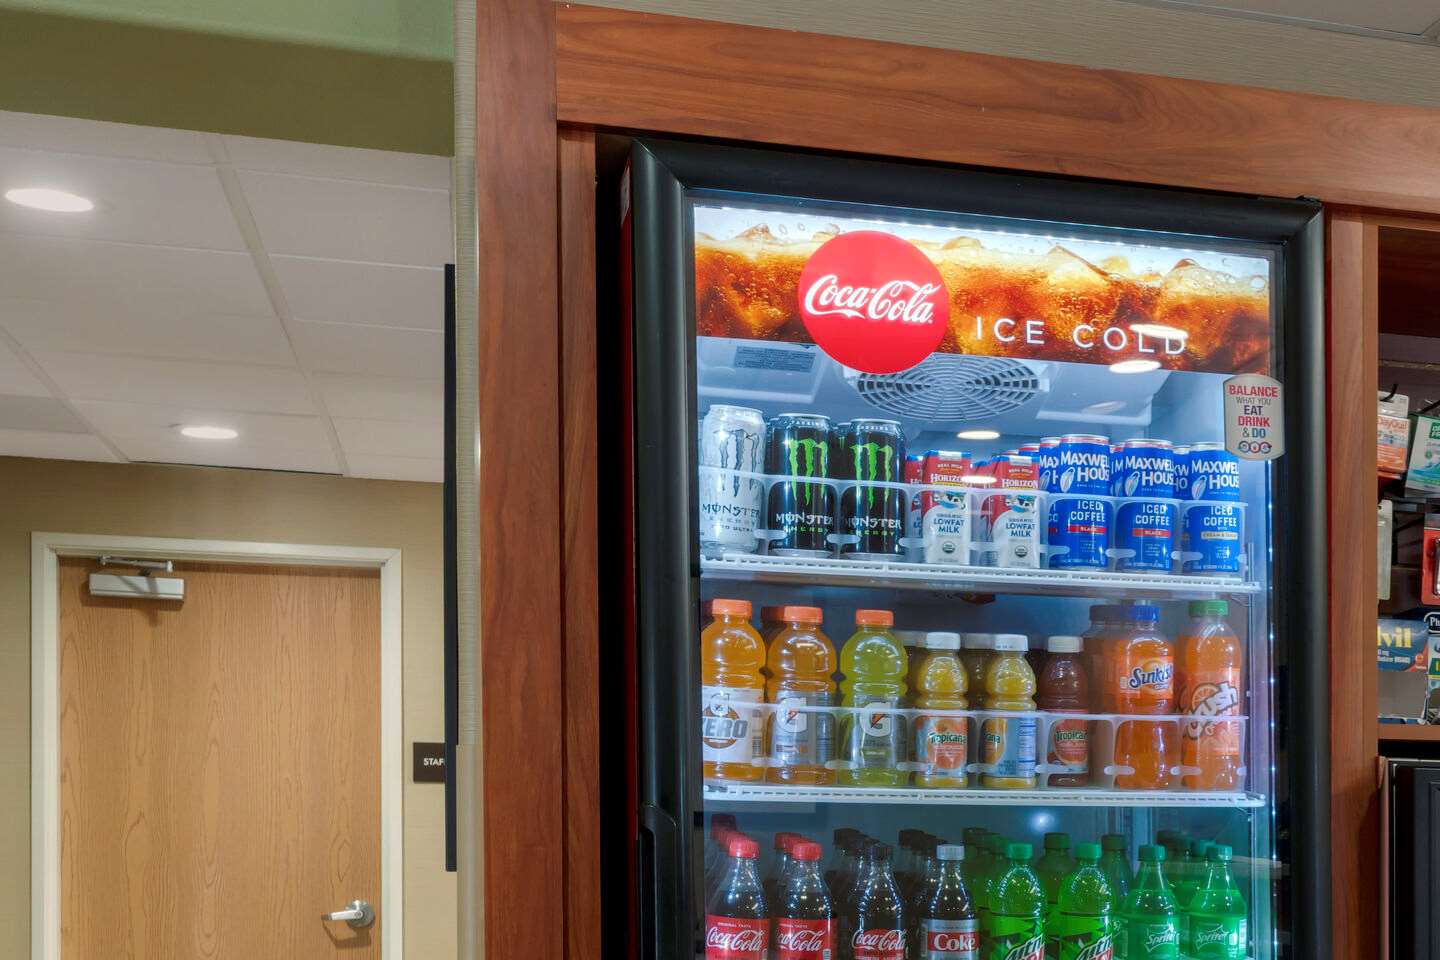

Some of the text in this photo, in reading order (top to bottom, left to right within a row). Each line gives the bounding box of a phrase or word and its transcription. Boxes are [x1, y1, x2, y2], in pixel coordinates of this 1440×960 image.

[803, 273, 942, 324] Coca-Cola
[974, 315, 1187, 356] ICE COLD
[1228, 384, 1279, 398] BALANCE
[1235, 396, 1271, 406] WHAT YOU
[1243, 404, 1264, 416] EAT
[1238, 416, 1271, 428] DRINK
[1242, 427, 1267, 439] & DO
[1001, 478, 1039, 489] HORIZON
[1077, 500, 1102, 511] ICED
[1142, 503, 1168, 514] ICED
[1210, 505, 1233, 516] ICED
[1070, 511, 1106, 522] COFFEE
[1135, 513, 1170, 526] COFFEE
[1203, 516, 1237, 527] COFFEE
[933, 518, 966, 527] LOWFAT
[1005, 522, 1037, 531] LOWFAT
[938, 525, 960, 534] MILK
[1010, 529, 1032, 537] MILK
[704, 717, 748, 739] ERO
[706, 926, 765, 952] Coca-Cola
[933, 933, 976, 951] Coke
